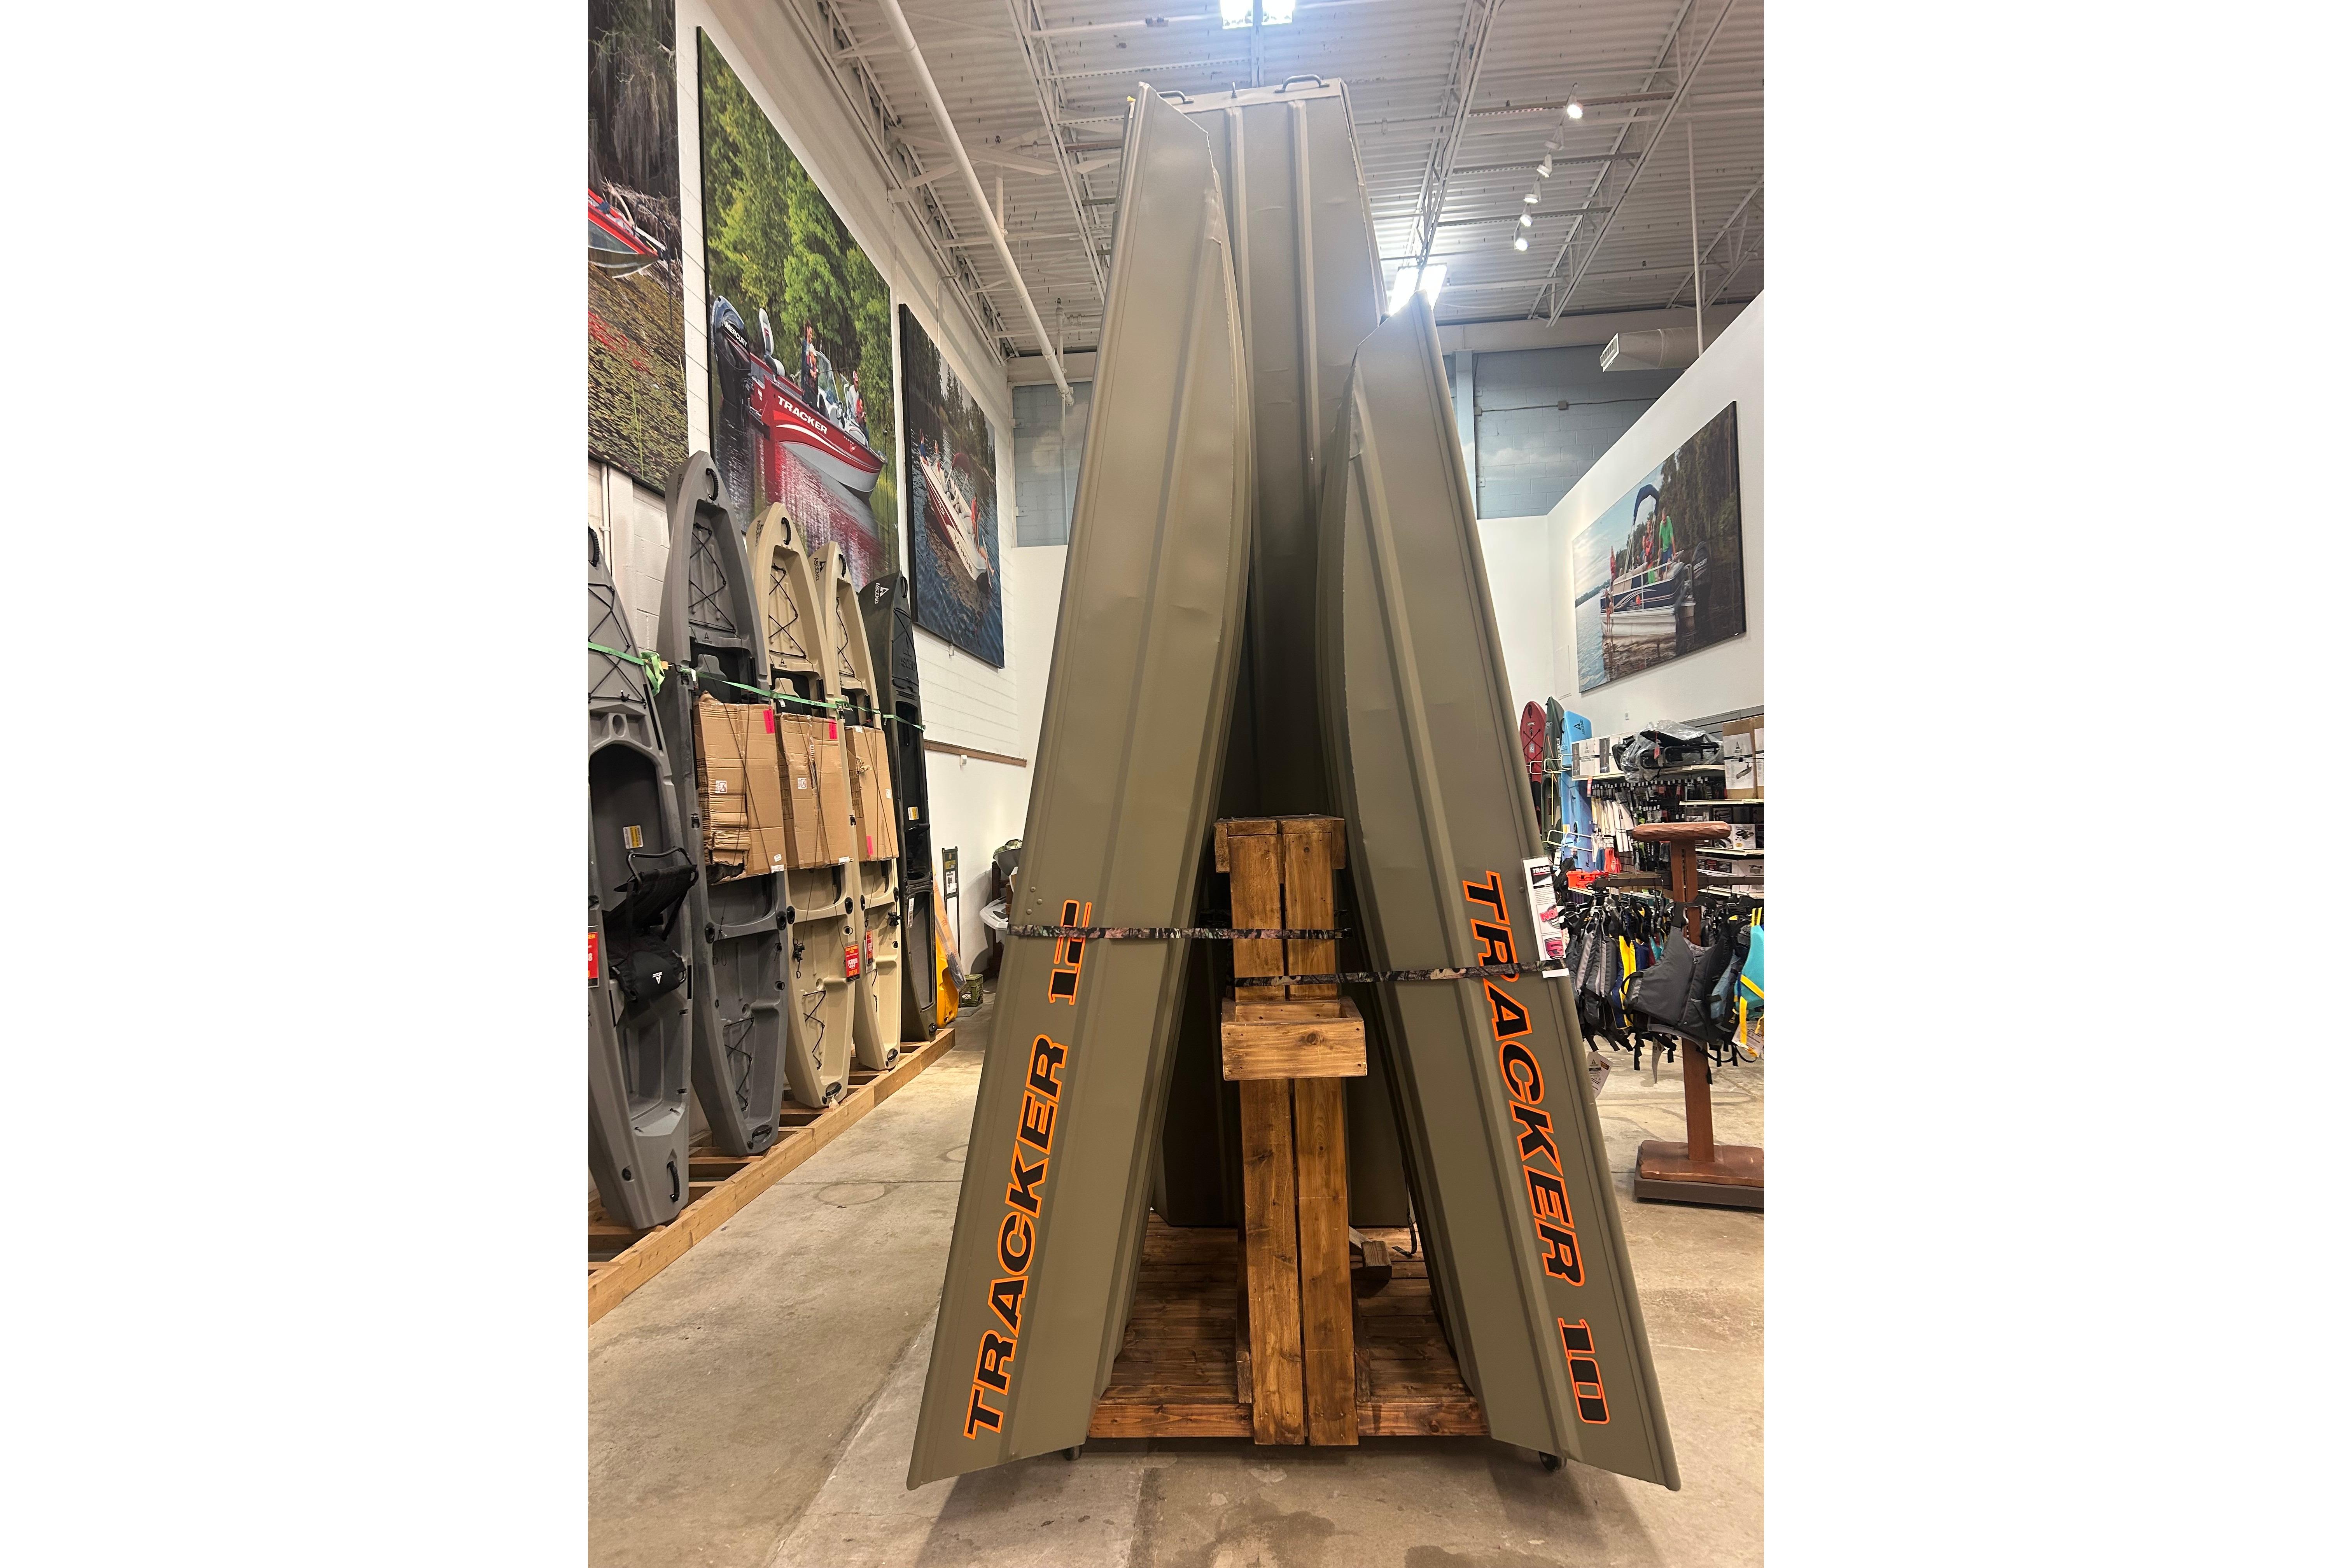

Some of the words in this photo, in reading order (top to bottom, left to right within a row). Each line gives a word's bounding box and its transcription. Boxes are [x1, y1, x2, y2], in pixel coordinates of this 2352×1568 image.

[725, 322, 747, 347] MERCURY
[778, 395, 828, 435] TRACKER
[963, 1034, 1068, 1440] TRACKER
[1462, 870, 1586, 1286] TRACKER
[1557, 1318, 1610, 1424] 10
